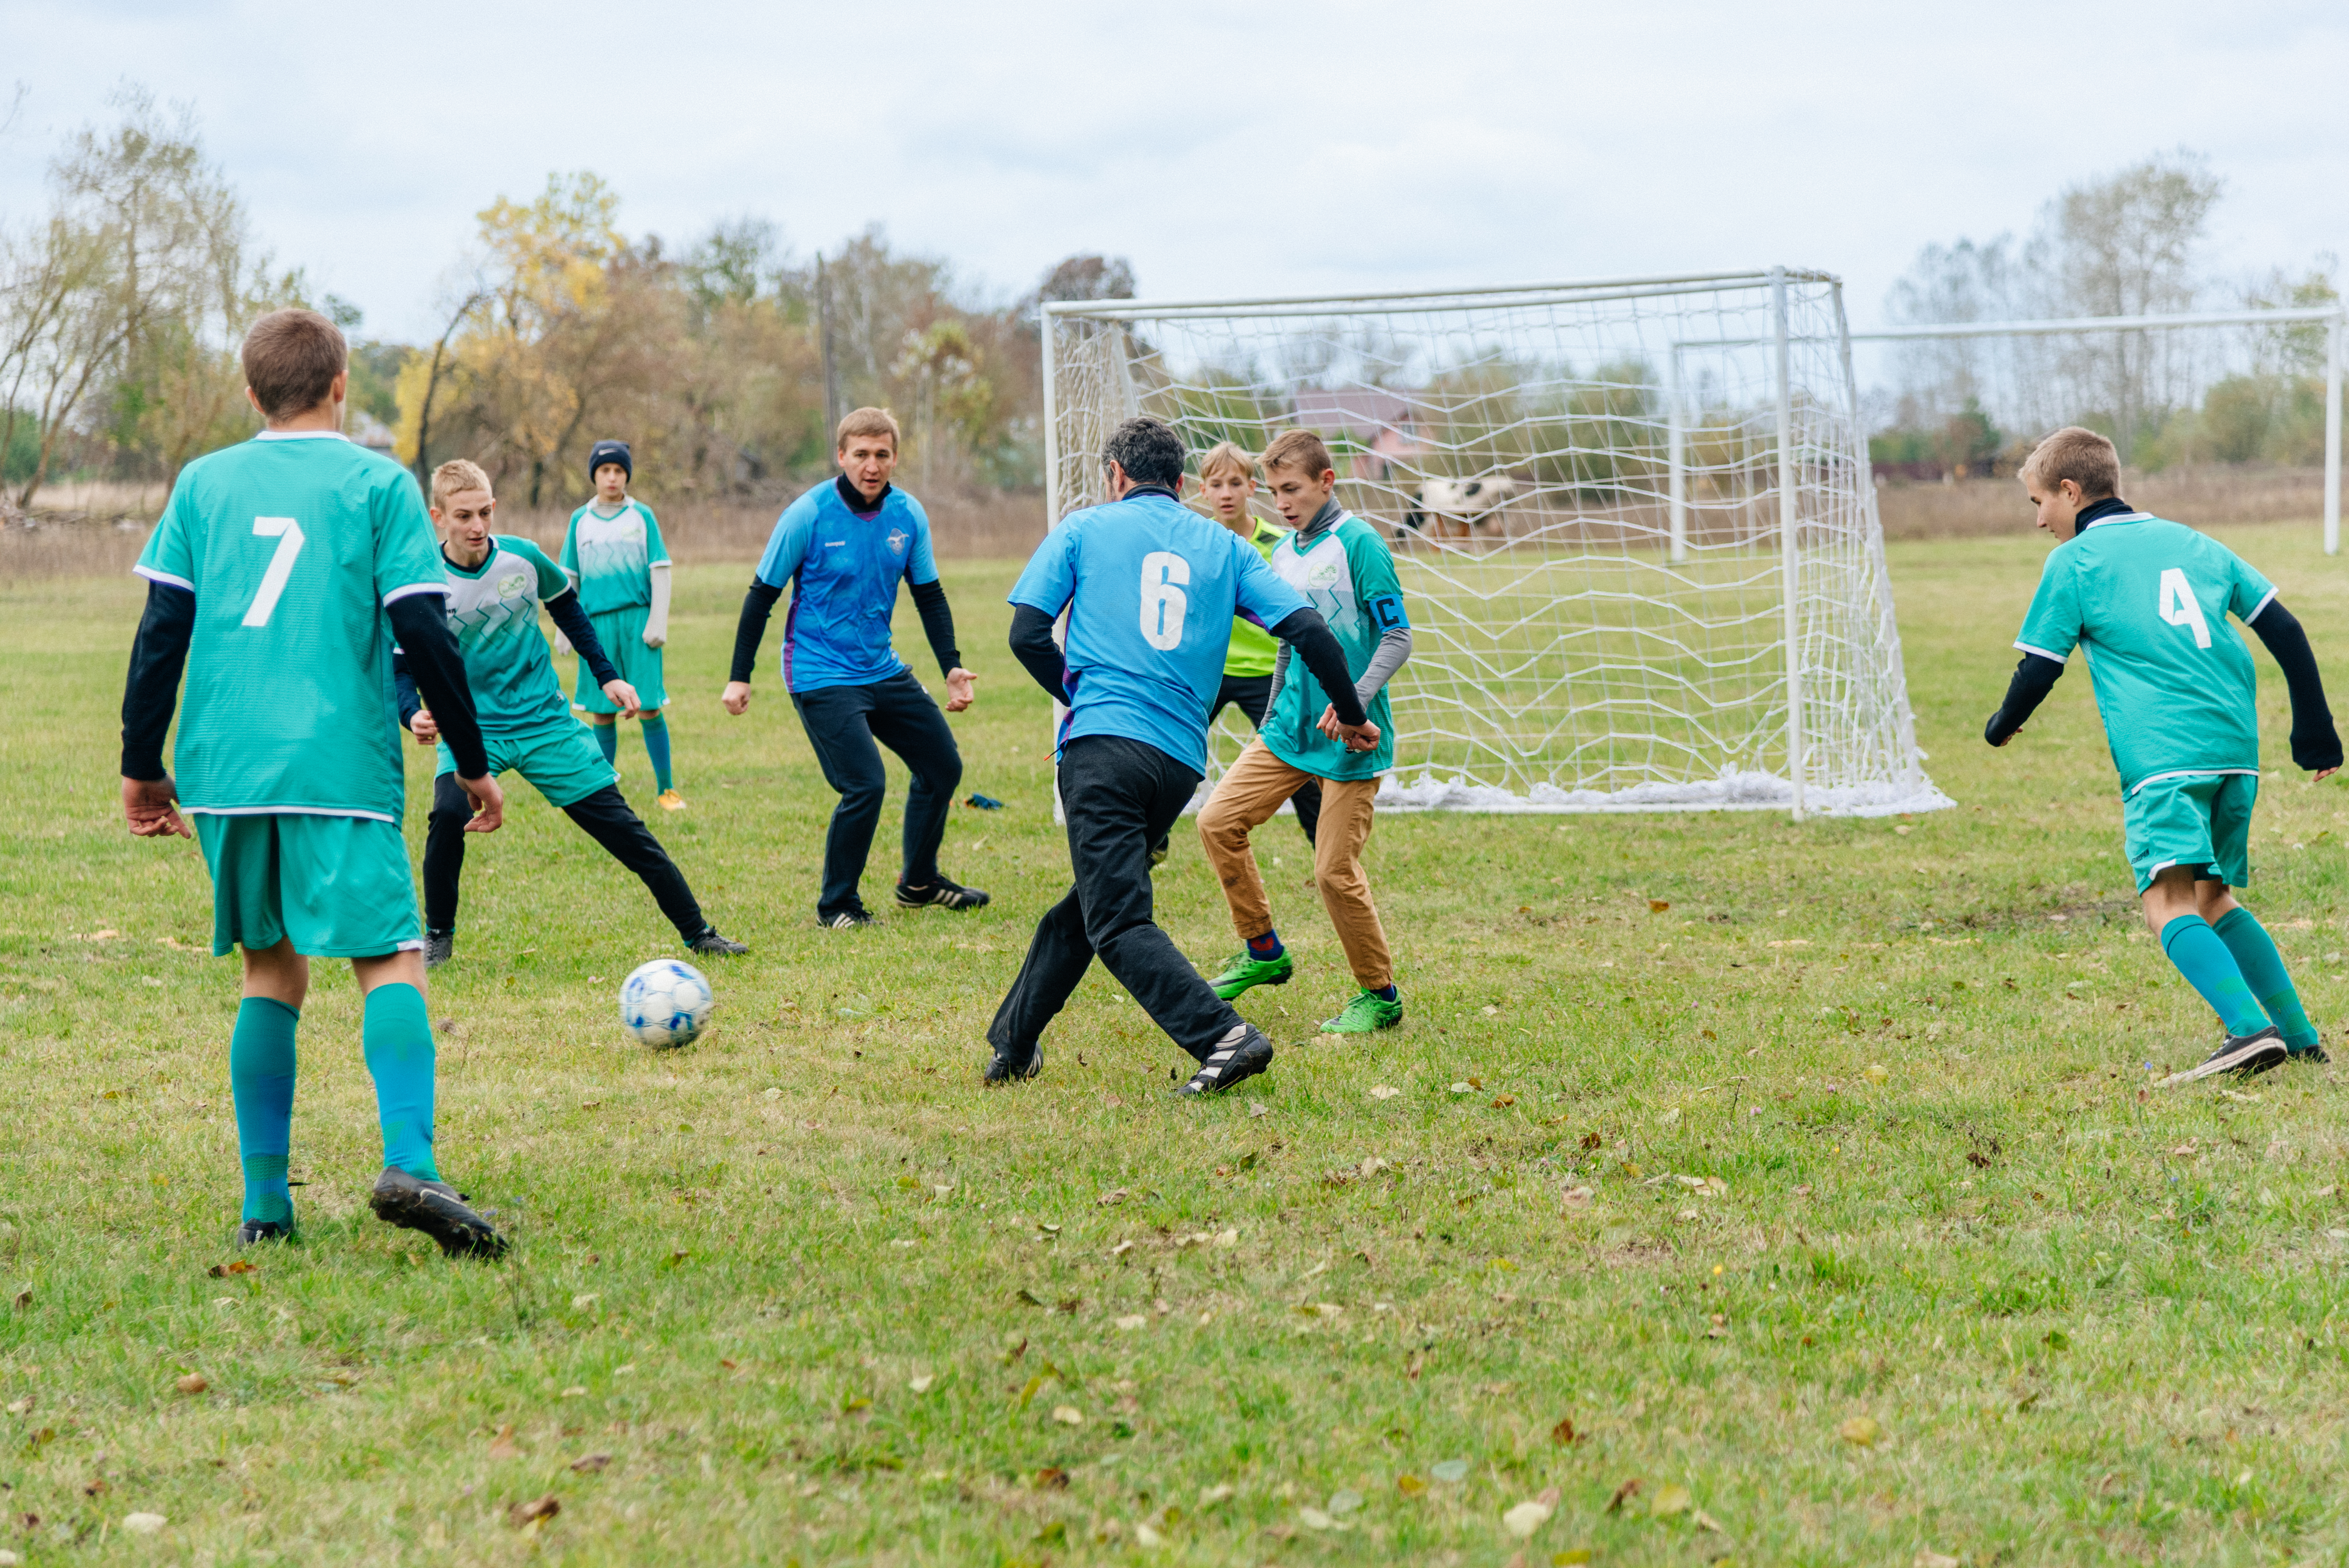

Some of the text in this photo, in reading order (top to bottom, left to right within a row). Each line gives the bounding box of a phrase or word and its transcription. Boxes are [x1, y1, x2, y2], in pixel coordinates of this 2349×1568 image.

[241, 516, 305, 626] 7
[1139, 551, 1190, 650] 6
[1376, 598, 1400, 627] C
[2159, 568, 2212, 649] 4
